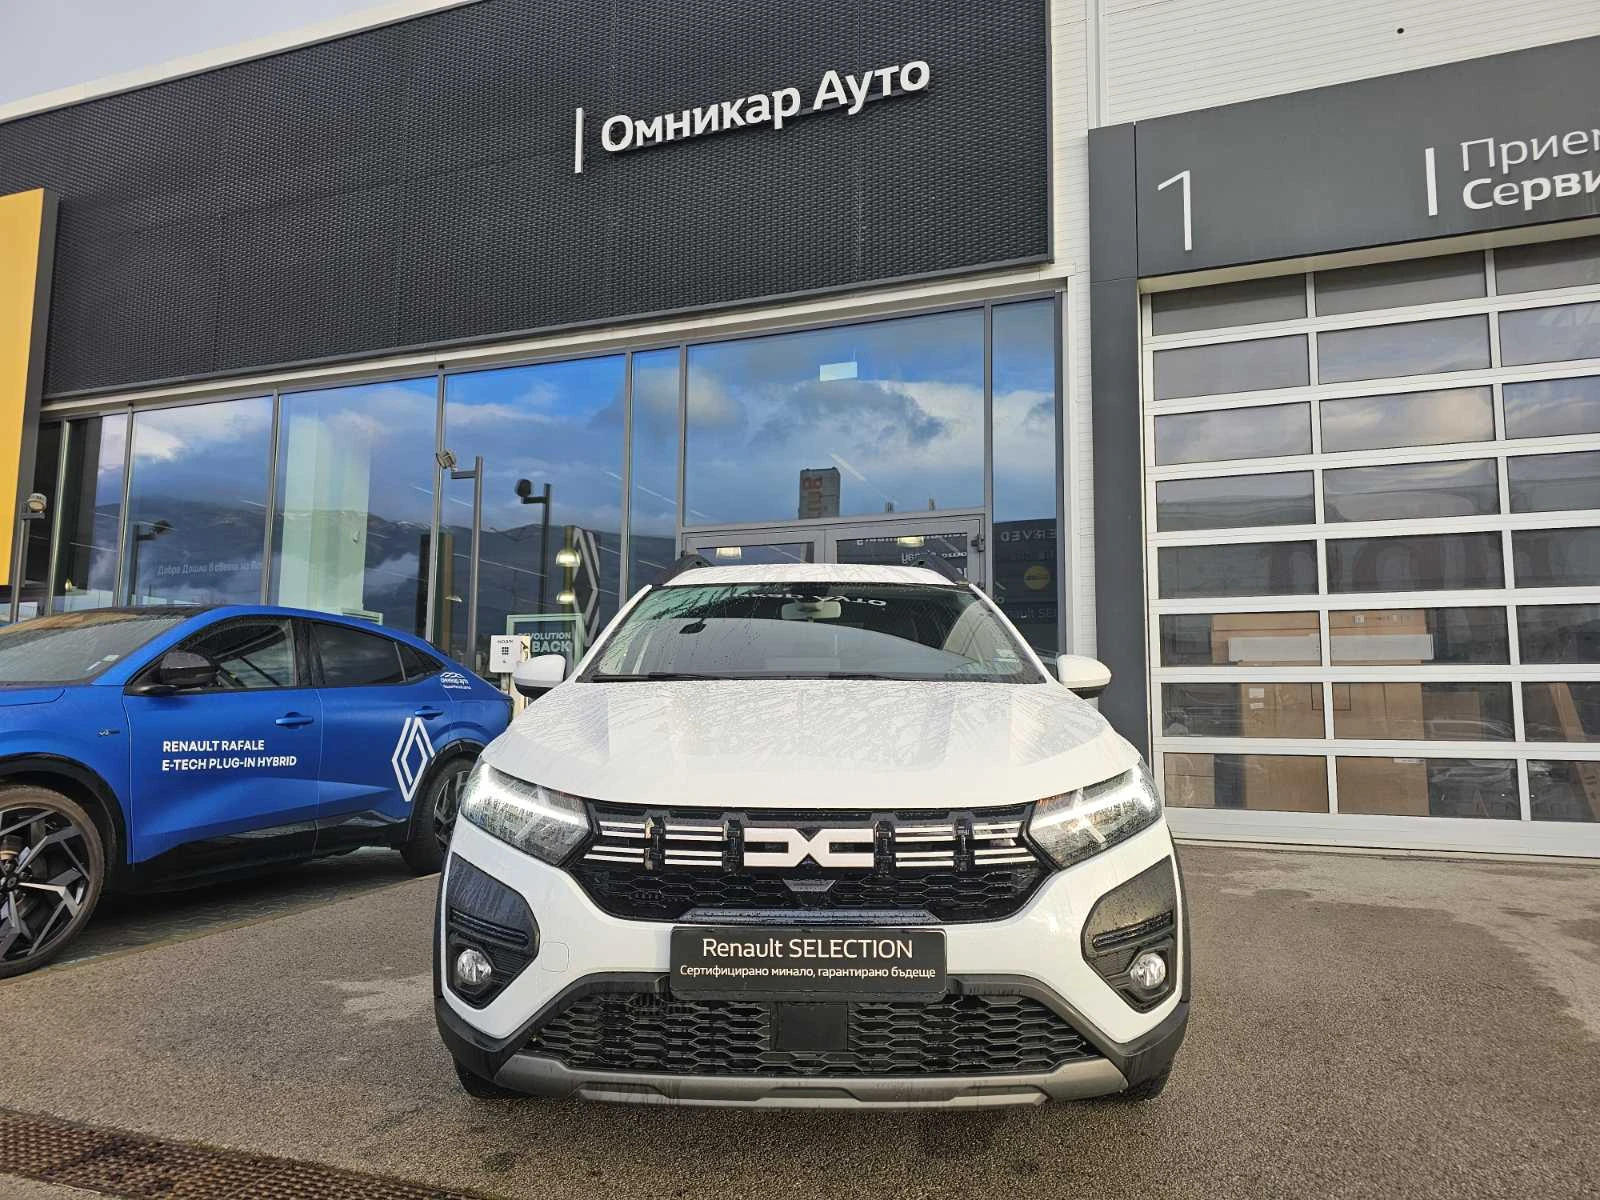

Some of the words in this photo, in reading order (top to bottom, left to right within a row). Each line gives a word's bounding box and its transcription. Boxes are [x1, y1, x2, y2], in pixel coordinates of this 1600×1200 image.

[601, 85, 801, 152] Омникар
[813, 60, 931, 114] Ауто
[1157, 169, 1193, 251] 1
[532, 641, 570, 652] BACK
[163, 740, 220, 752] RENAULT
[221, 740, 265, 751] RAFALE
[162, 759, 207, 771] E-TECH
[208, 757, 256, 769] PLUG-IN
[257, 755, 297, 767] HYBRID
[702, 938, 783, 957] Renault
[789, 939, 913, 958] SELECTION
[680, 965, 769, 978] Сертифицирано
[771, 967, 816, 978] минало,
[818, 968, 889, 978] гарантирано
[891, 966, 936, 978] бъдеще
